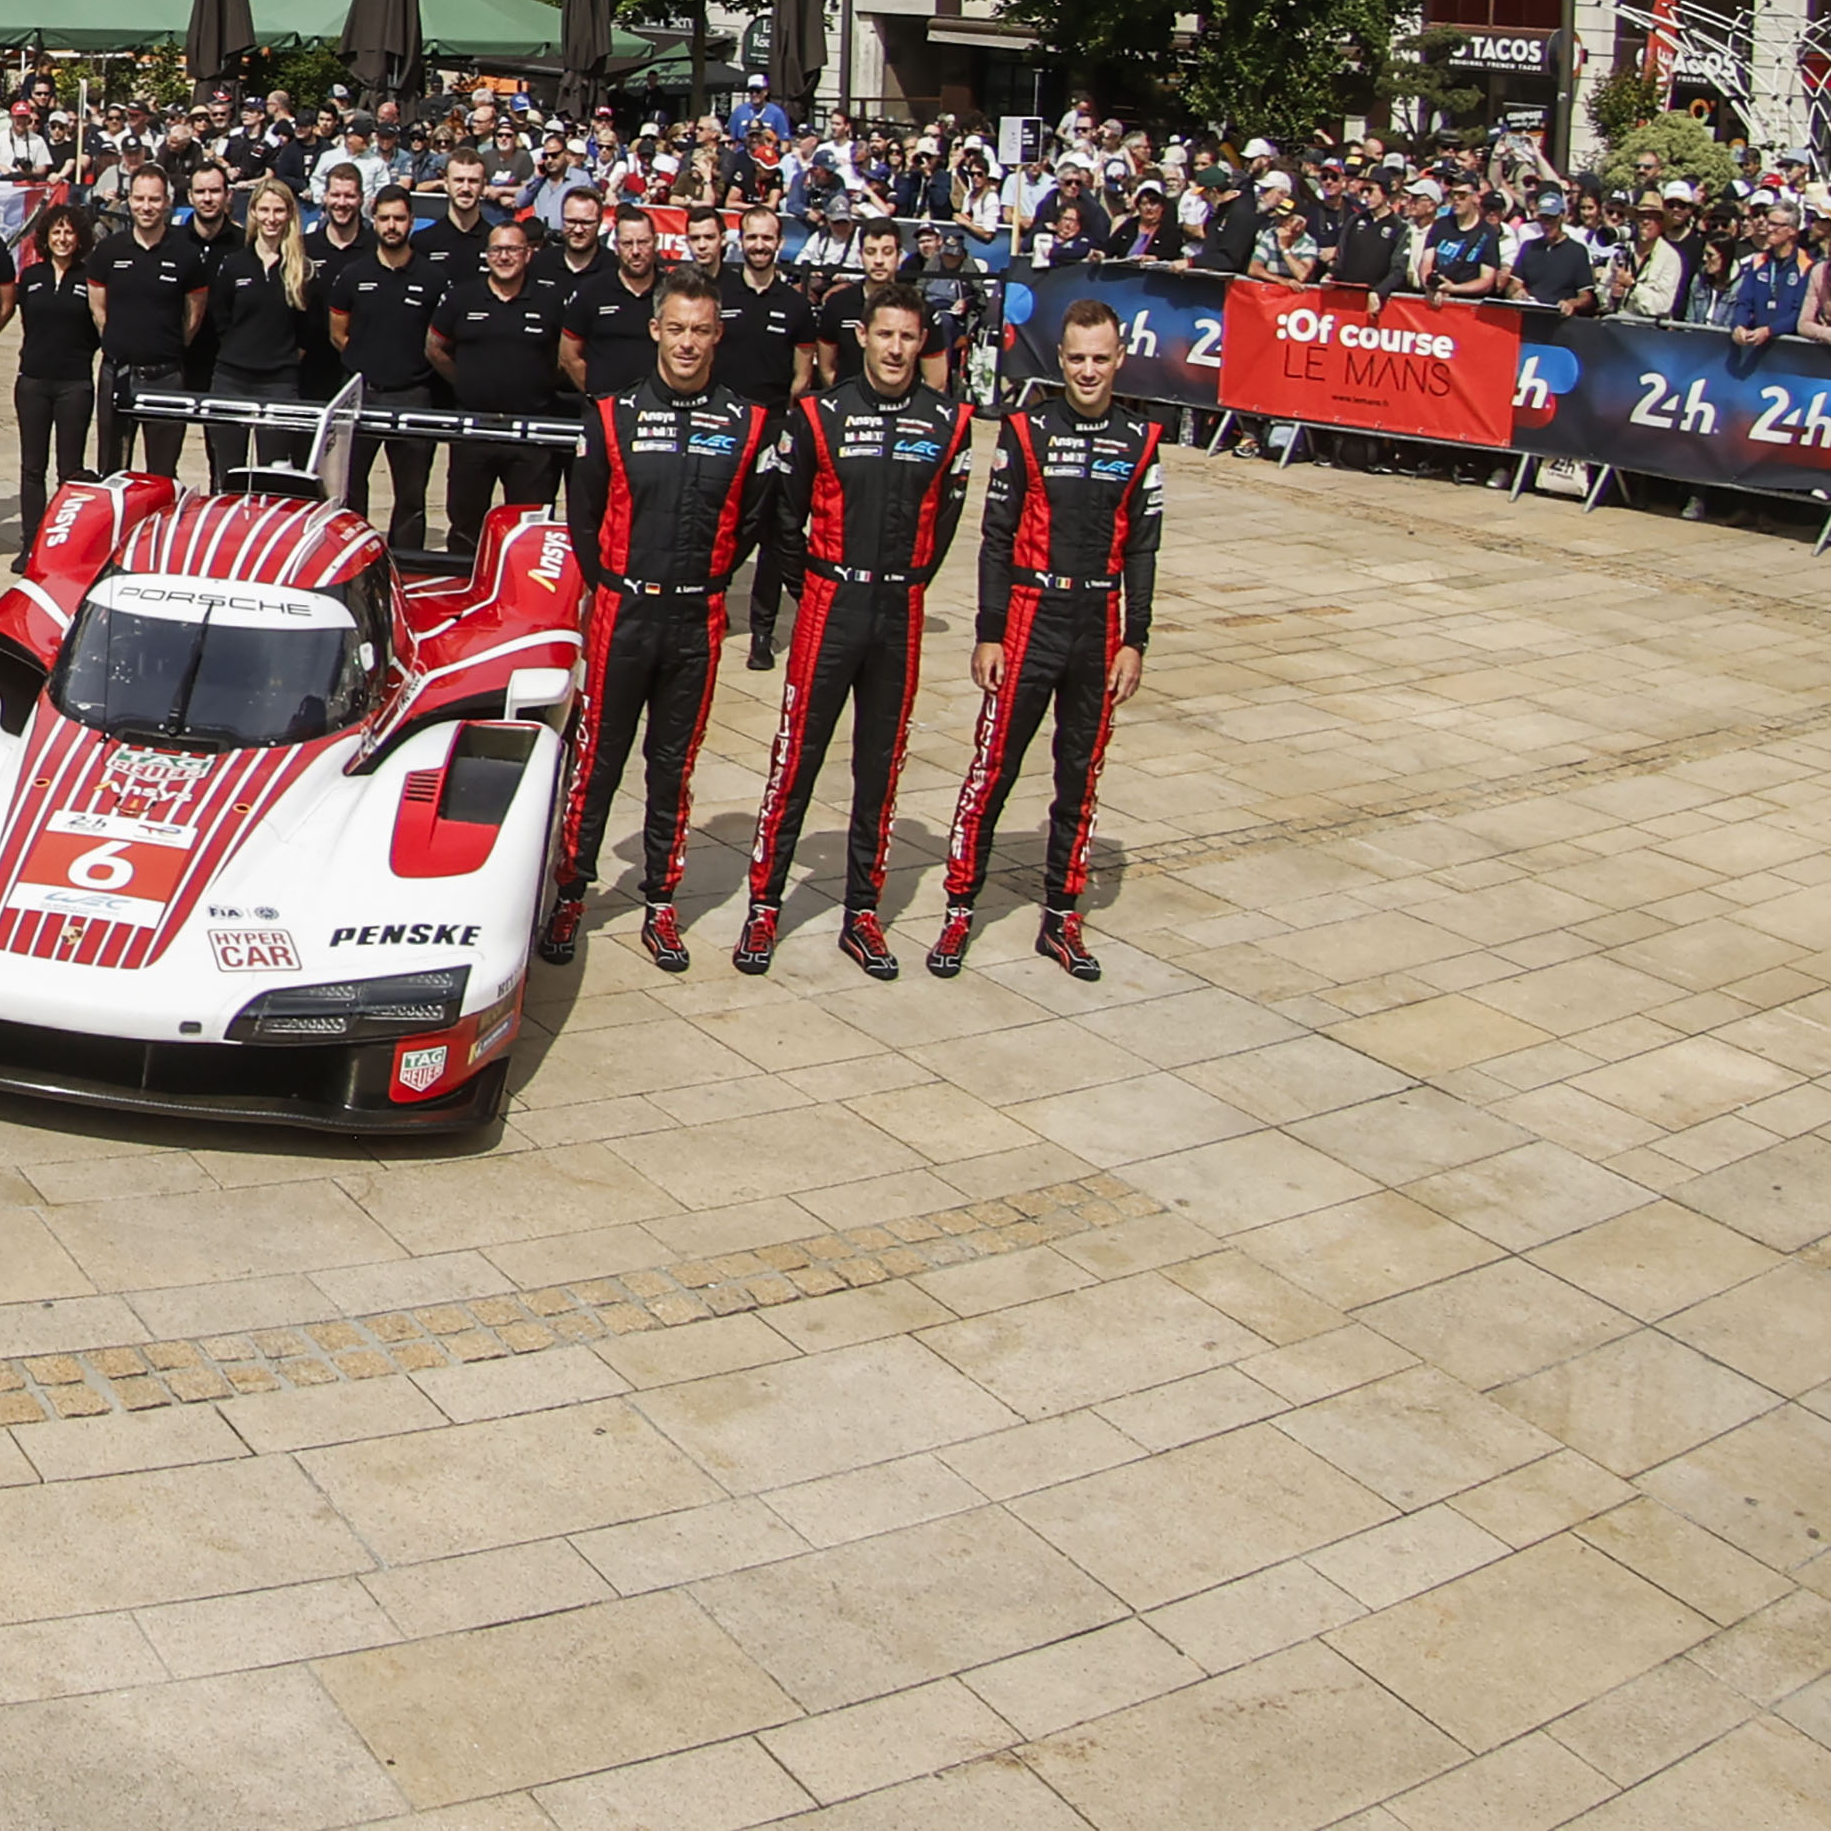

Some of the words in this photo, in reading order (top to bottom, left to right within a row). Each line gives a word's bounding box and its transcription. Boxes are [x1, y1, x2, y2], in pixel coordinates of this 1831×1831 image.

[1471, 37, 1542, 63] TACOS
[1339, 323, 1454, 359] course
[1284, 344, 1328, 381] LE
[1344, 353, 1451, 397] MANS
[638, 411, 675, 422] Ansys
[845, 416, 883, 427] Ansys
[1048, 436, 1085, 448] Ansys
[47, 491, 94, 548] Ansys
[528, 531, 571, 591] Ansys
[118, 586, 312, 618] PORSCHE
[113, 760, 206, 778] HEUER
[117, 751, 208, 770] TAG
[94, 780, 192, 802] Ansys
[67, 840, 134, 890] 6
[208, 907, 240, 919] FIA
[216, 932, 286, 945] HYPER
[330, 924, 481, 947] PENSKE
[221, 946, 294, 967] CAR
[408, 1050, 443, 1067] TAG
[403, 1066, 443, 1090] HEUER
